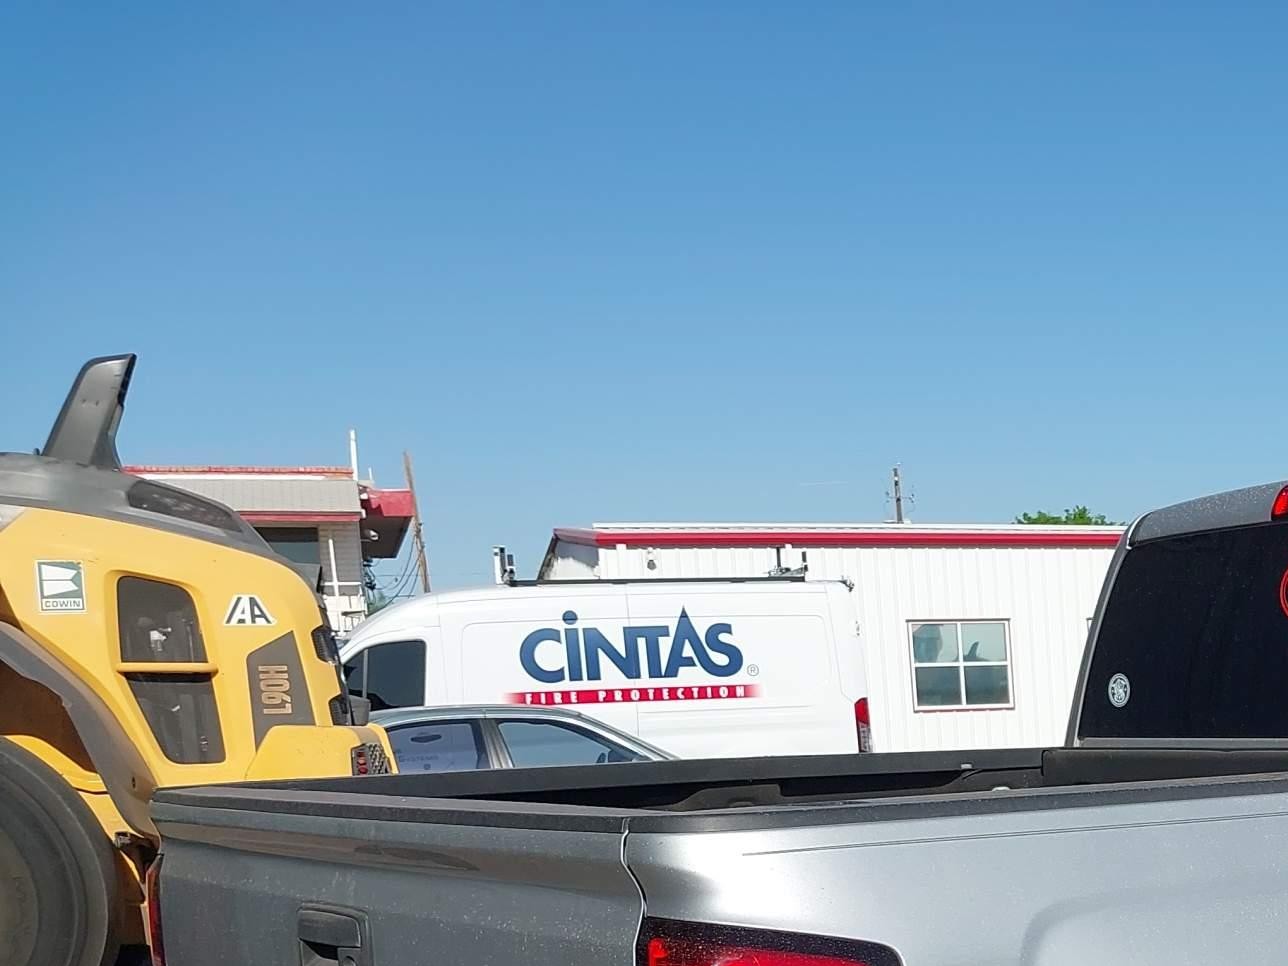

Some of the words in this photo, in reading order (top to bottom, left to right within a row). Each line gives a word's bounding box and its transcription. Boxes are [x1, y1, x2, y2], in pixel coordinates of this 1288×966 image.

[44, 599, 81, 608] COWIN
[525, 691, 578, 705] FIRE
[597, 686, 745, 702] PROTECTION
